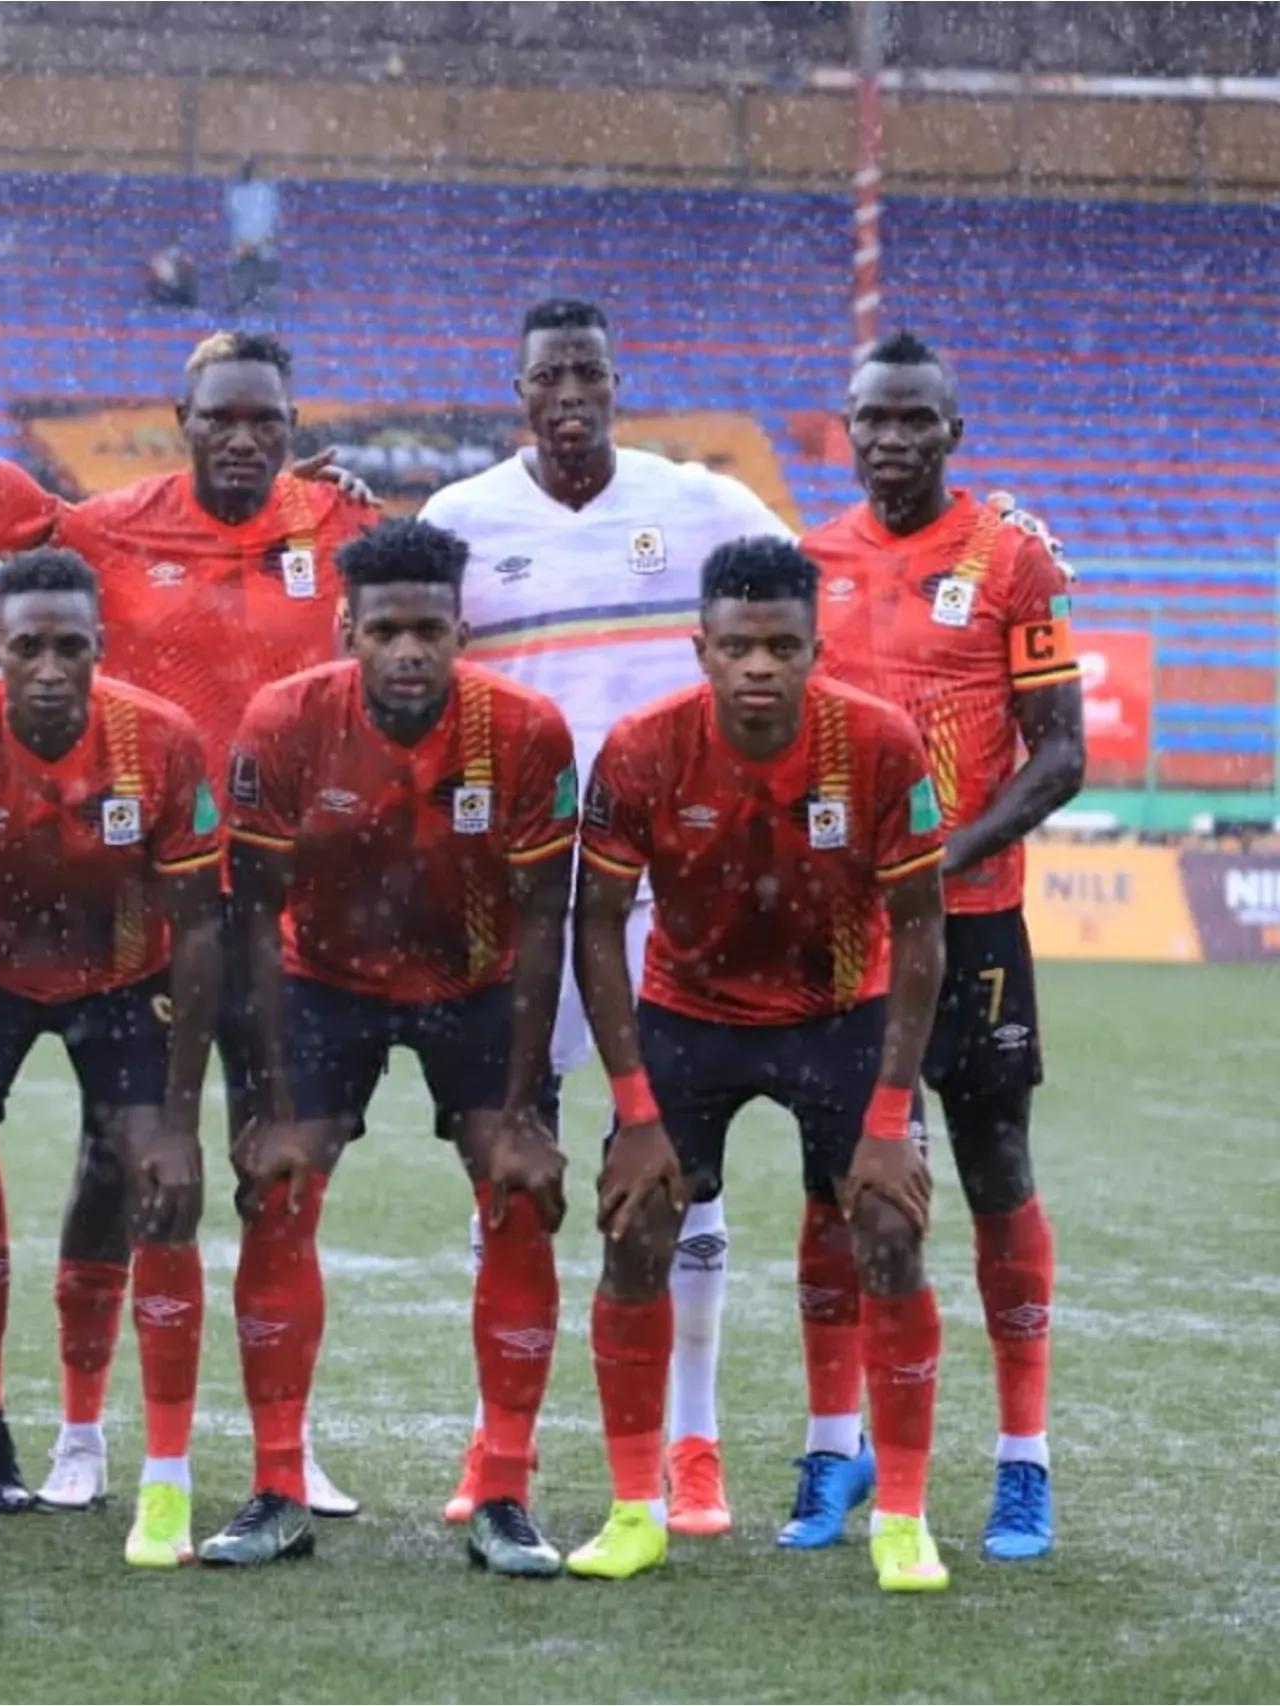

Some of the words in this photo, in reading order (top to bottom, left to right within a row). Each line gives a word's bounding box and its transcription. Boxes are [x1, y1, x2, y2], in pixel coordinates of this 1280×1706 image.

[1026, 624, 1055, 661] C
[1044, 871, 1132, 902] NILE
[1224, 867, 1280, 909] NI
[978, 966, 1005, 1025] 7
